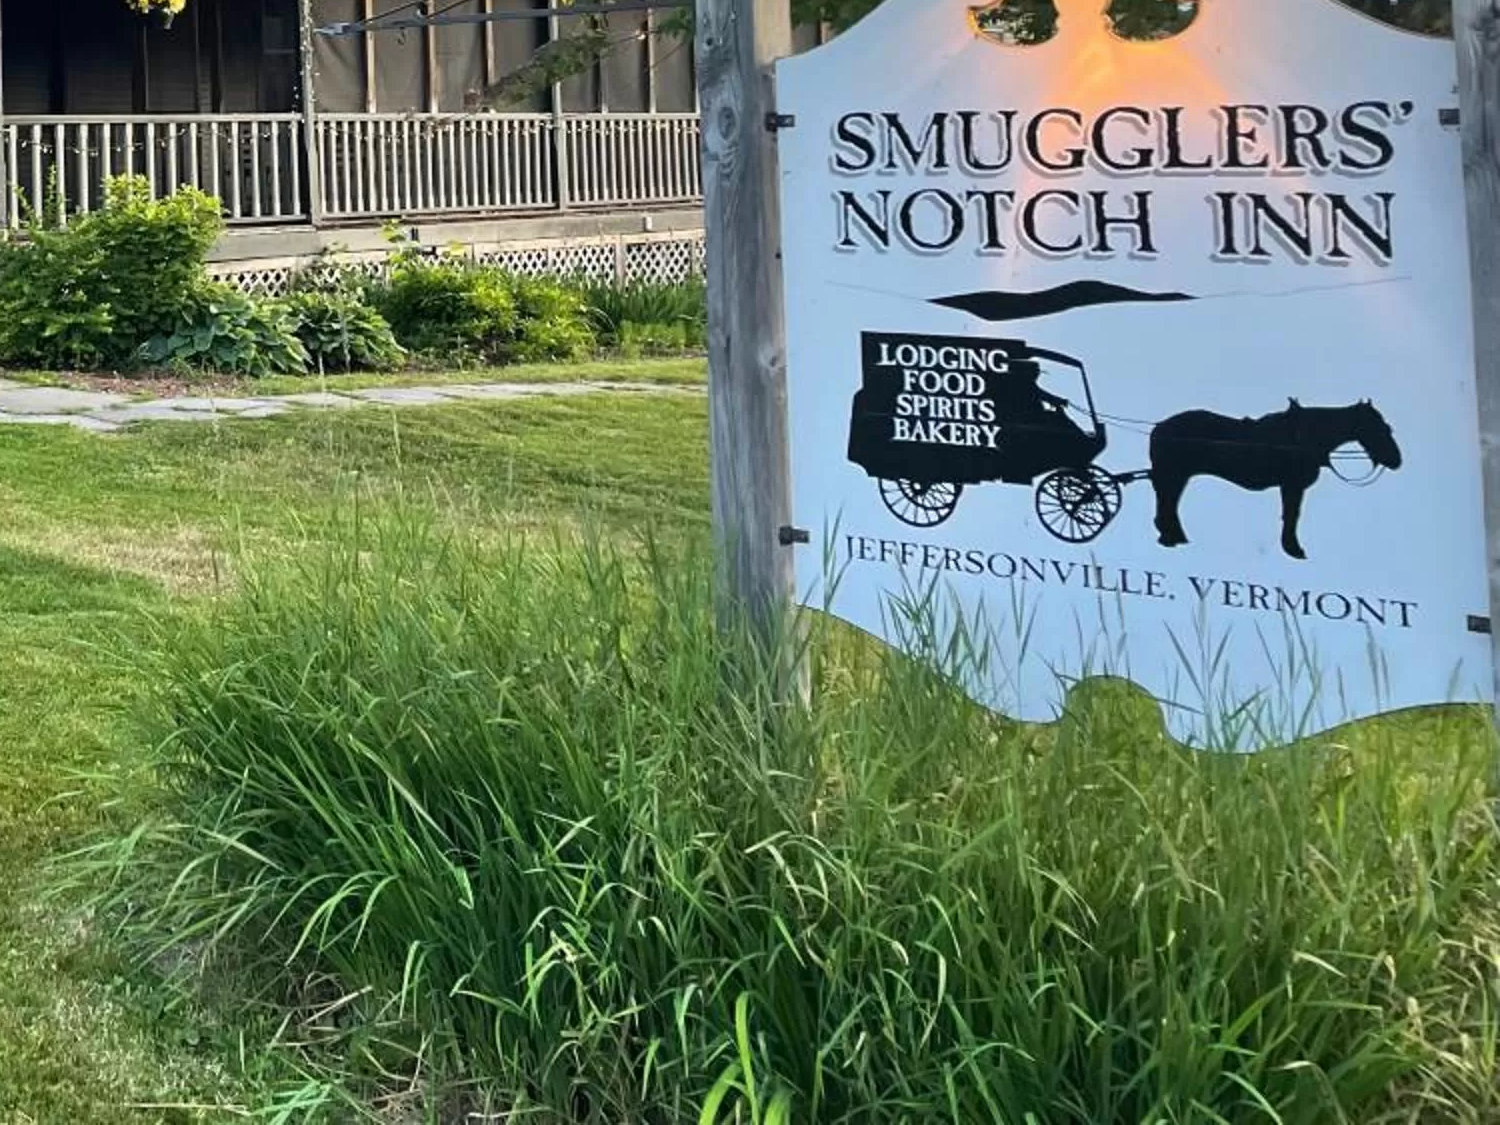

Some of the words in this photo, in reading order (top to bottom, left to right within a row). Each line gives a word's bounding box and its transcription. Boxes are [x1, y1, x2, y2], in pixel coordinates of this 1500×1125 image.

[834, 99, 1414, 173] SMUGGLERS'
[836, 188, 1157, 255] NOTCH
[1208, 191, 1396, 261] INN
[876, 343, 1009, 373] LODGING
[903, 369, 986, 396] FOOD
[895, 394, 996, 423] SPIRITS
[892, 416, 1002, 448] BAKERY
[1188, 576, 1418, 627] VERMONT
